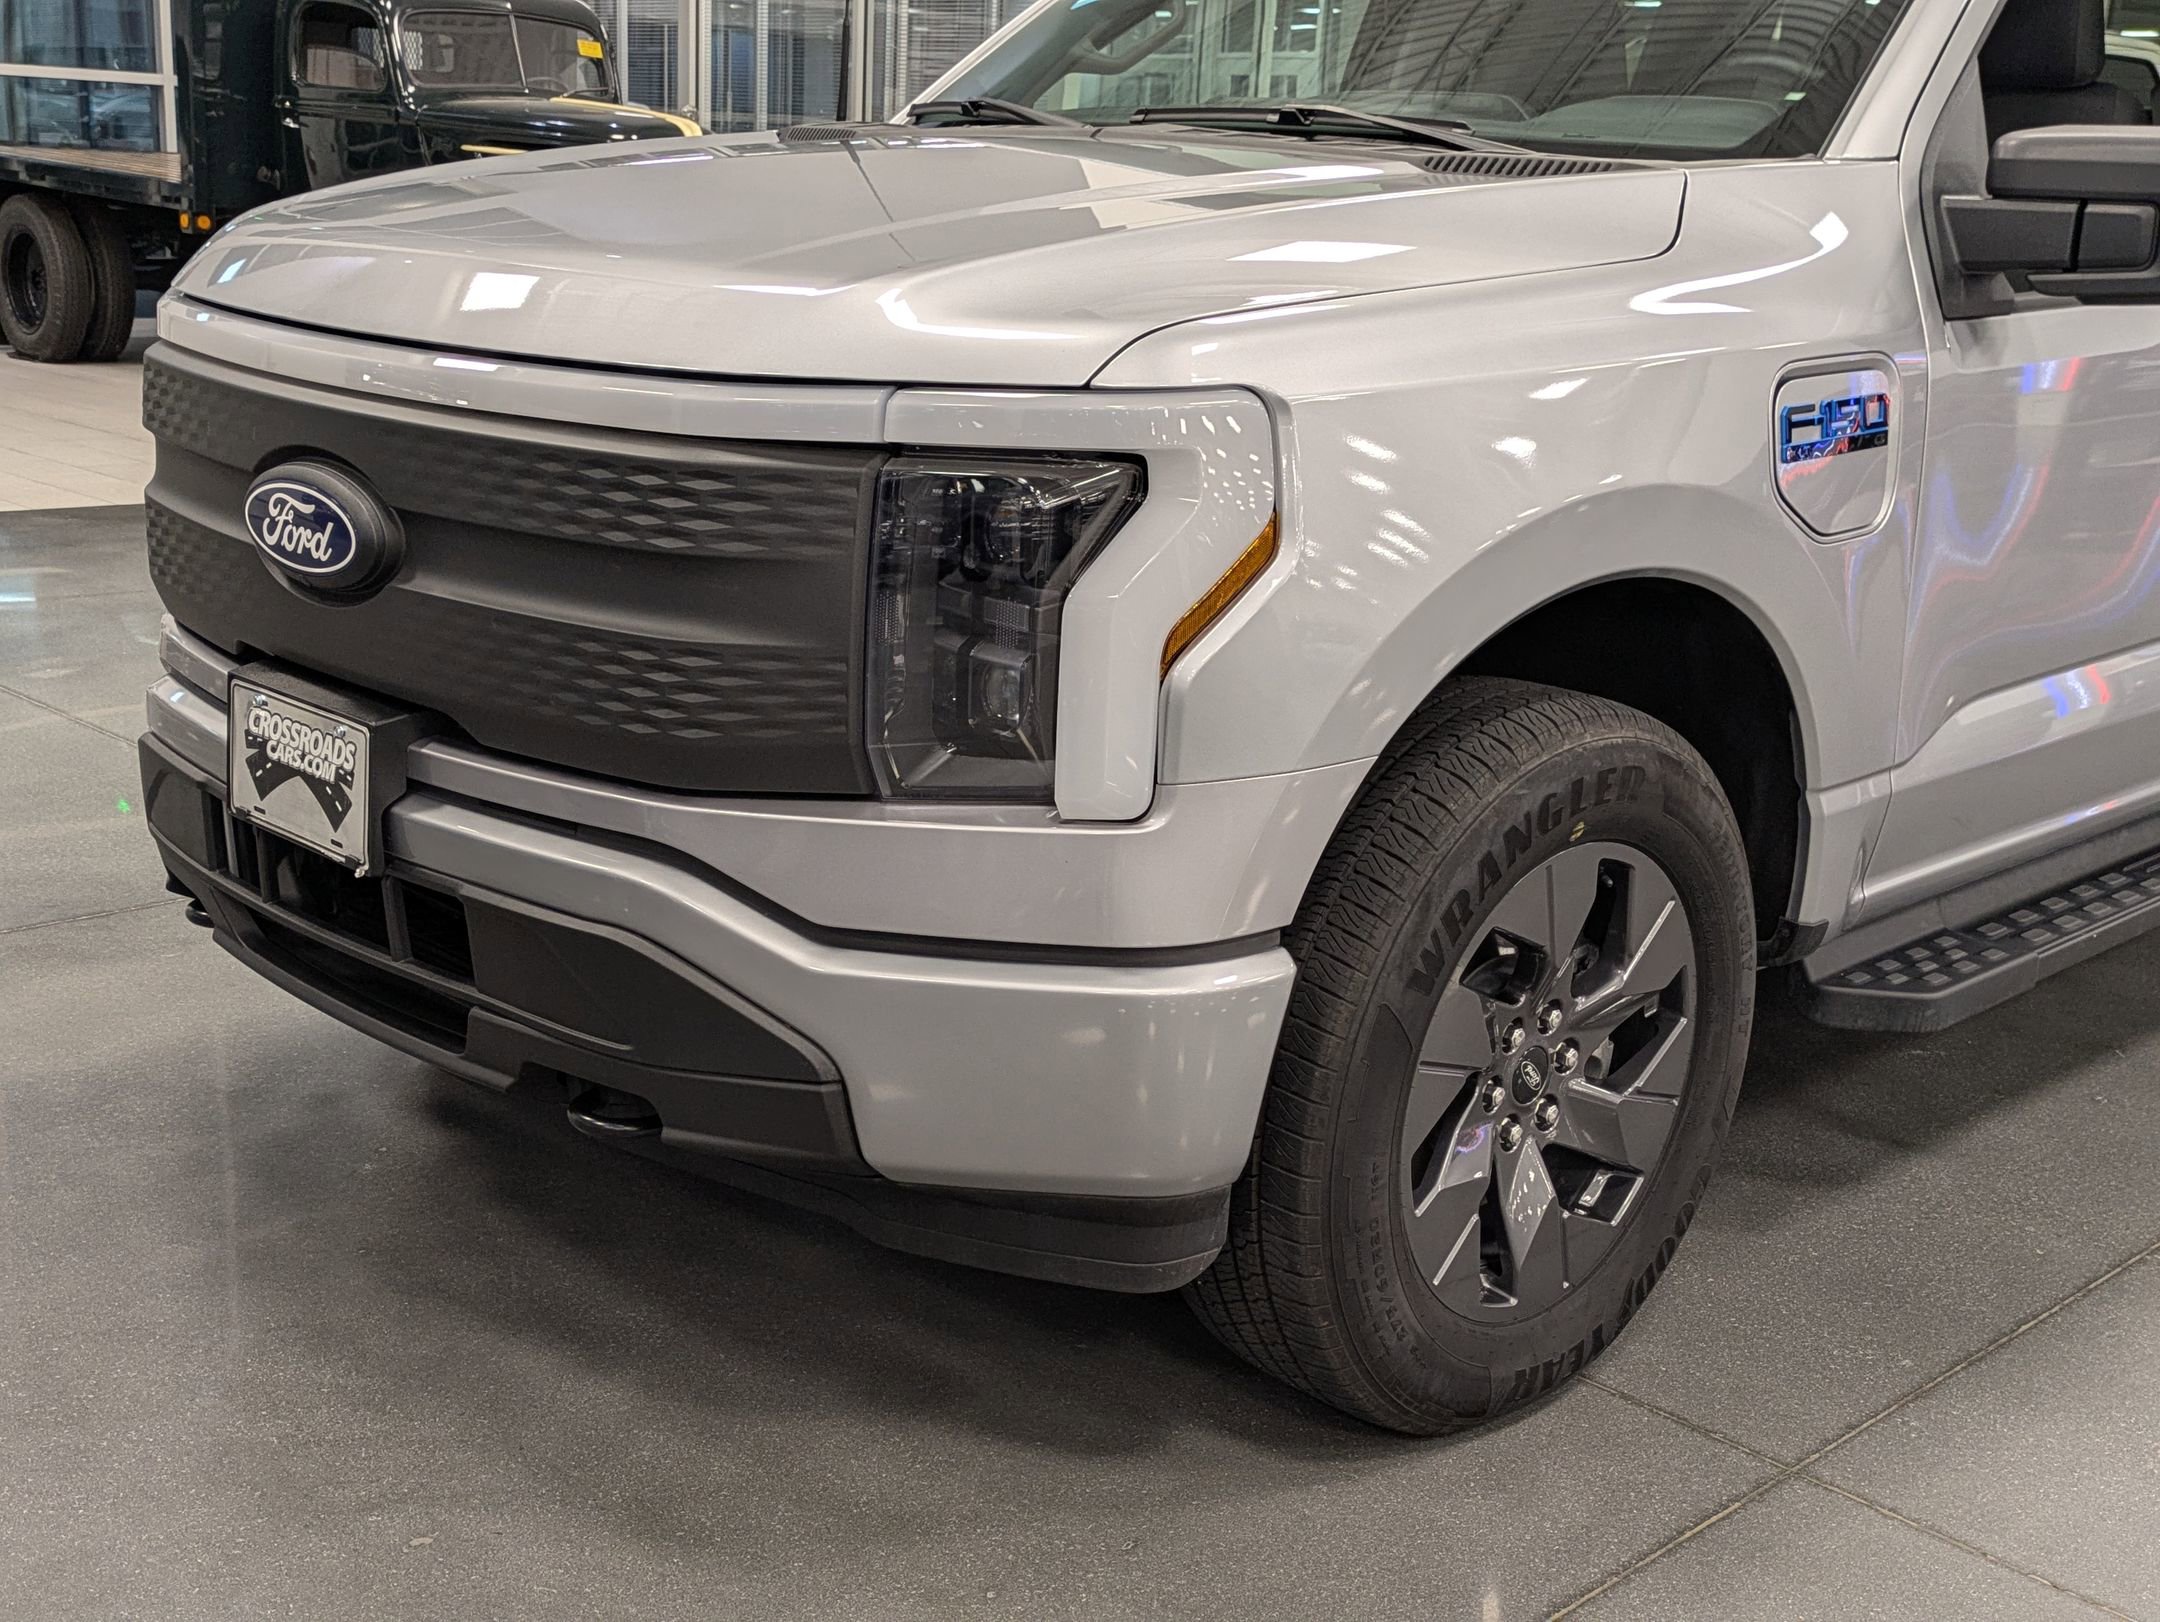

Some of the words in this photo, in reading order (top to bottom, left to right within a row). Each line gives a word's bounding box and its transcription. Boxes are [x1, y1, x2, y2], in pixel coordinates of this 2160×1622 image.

[1780, 393, 1891, 446] F-150
[262, 492, 334, 562] Ford
[246, 706, 357, 771] CROSSROADS
[265, 739, 337, 785] CARS.COM
[1404, 764, 1646, 997] WRANGLER
